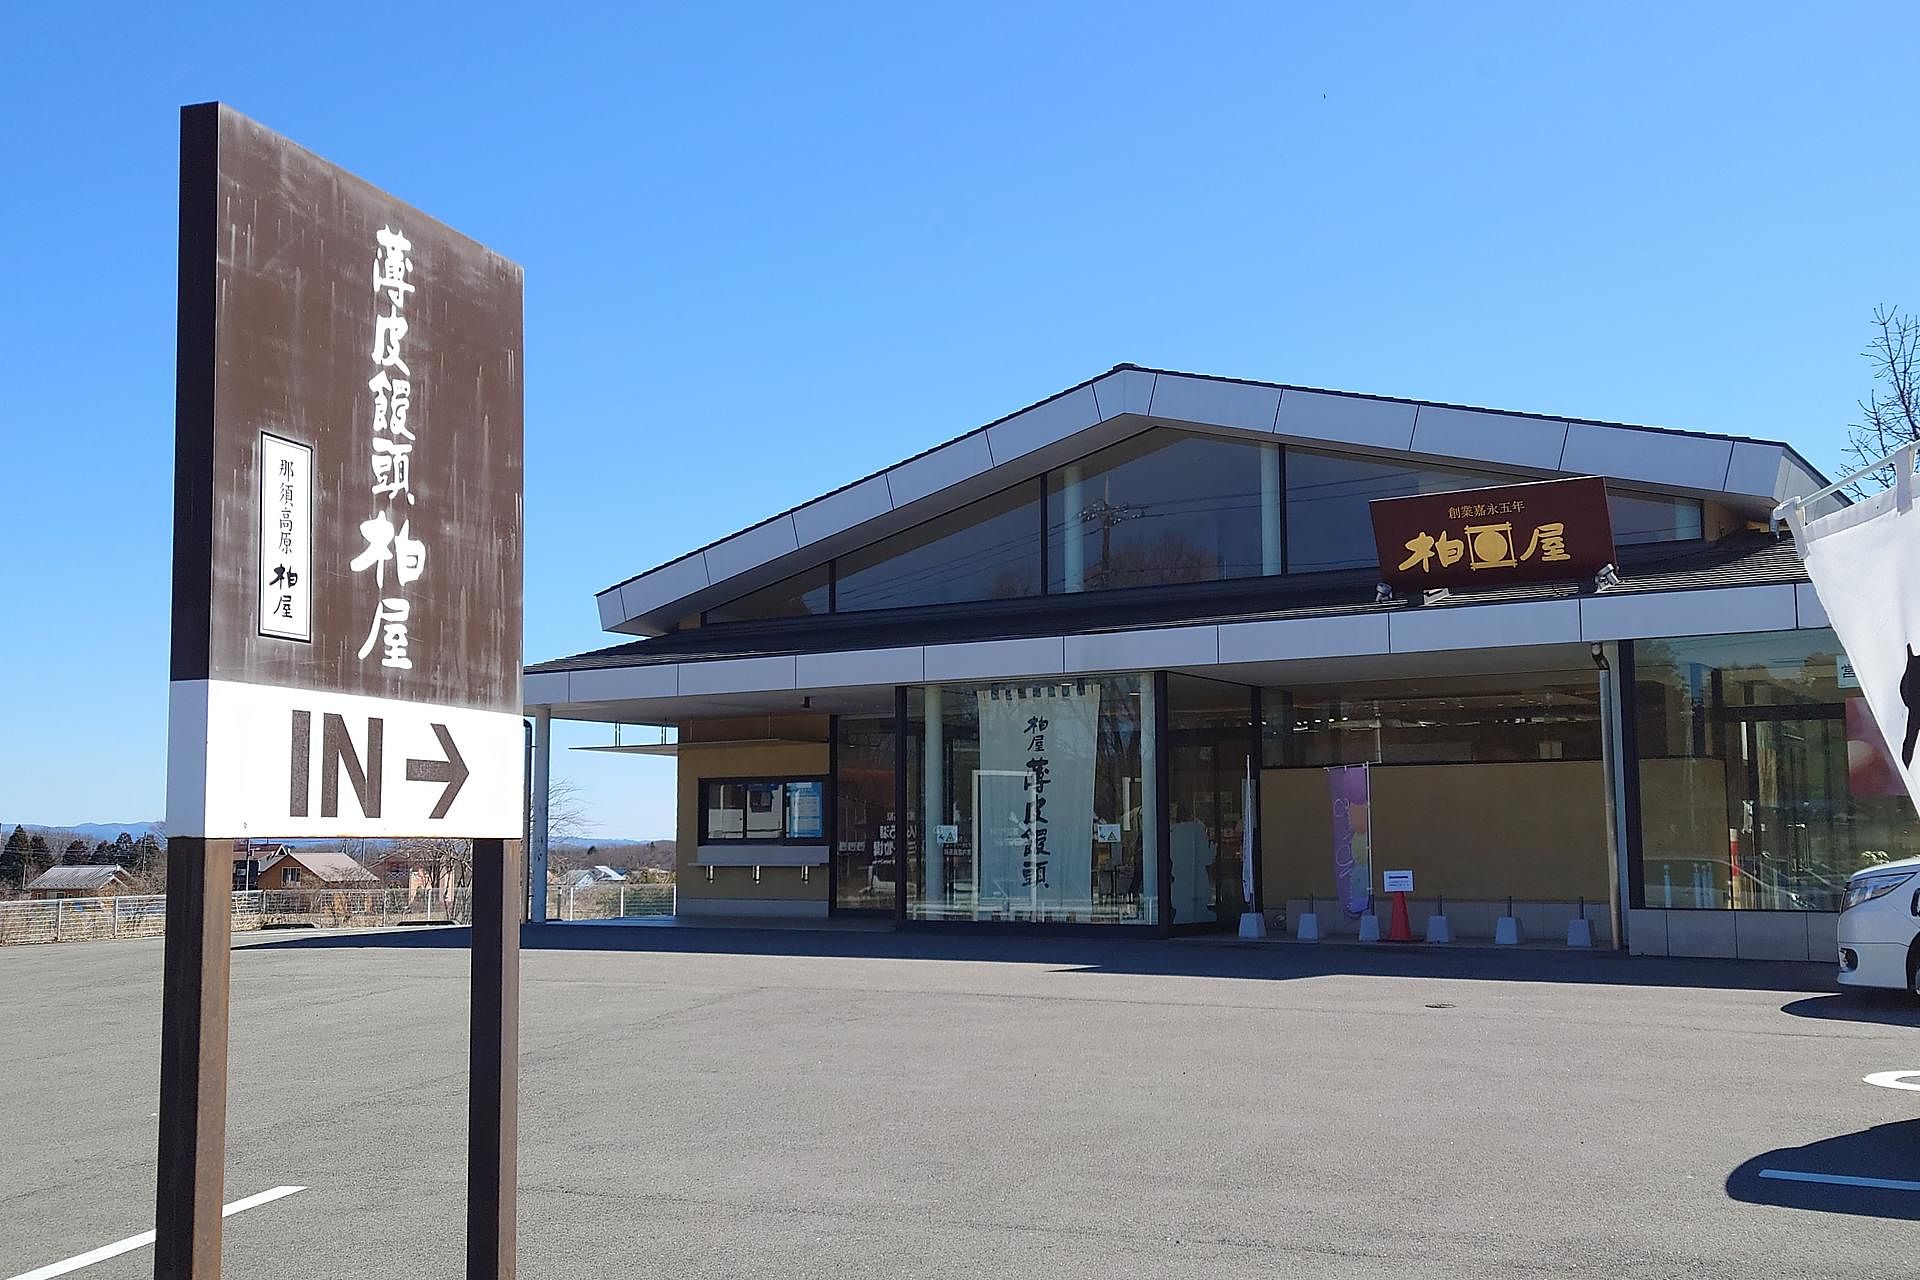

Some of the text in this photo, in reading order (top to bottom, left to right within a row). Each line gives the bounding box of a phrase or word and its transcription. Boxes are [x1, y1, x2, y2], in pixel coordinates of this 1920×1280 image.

[1448, 499, 1525, 520] 創業嘉永五年
[290, 709, 384, 819] IN
